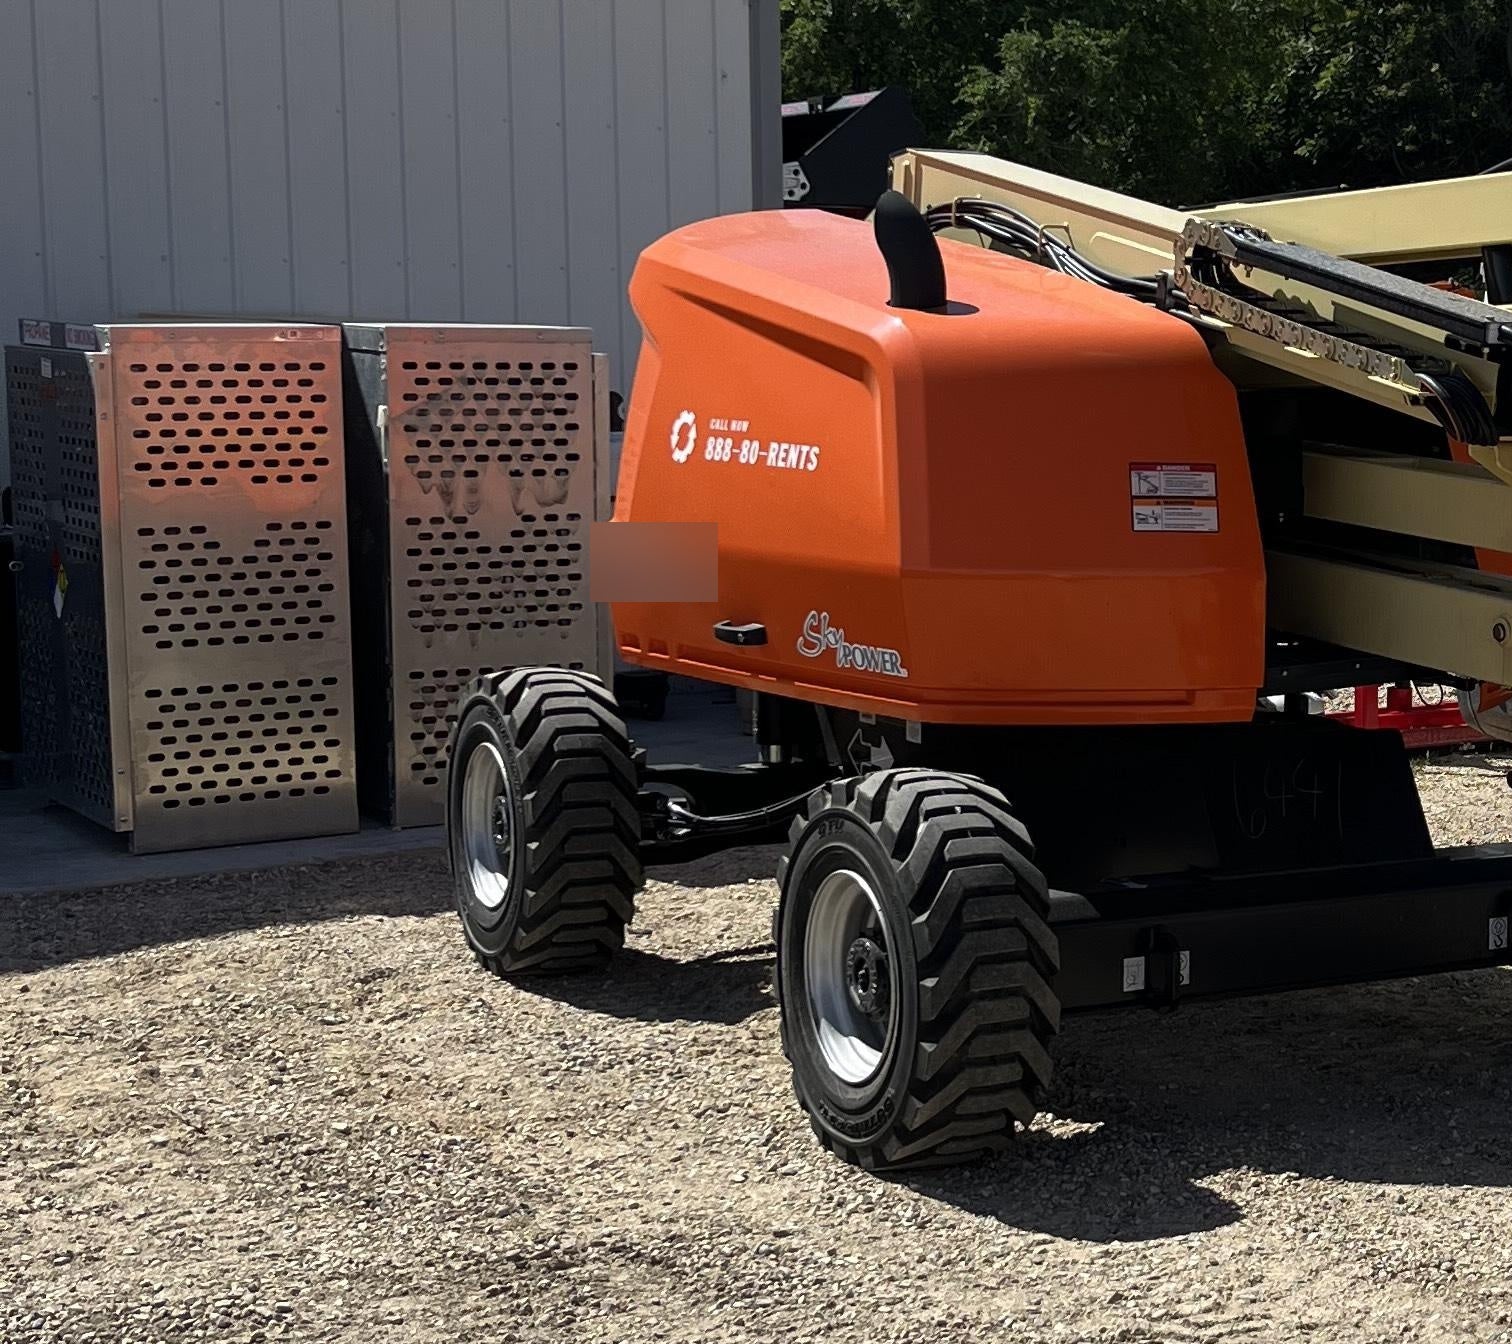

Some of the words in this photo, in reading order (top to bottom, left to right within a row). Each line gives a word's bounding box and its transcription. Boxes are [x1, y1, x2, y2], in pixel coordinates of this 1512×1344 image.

[709, 418, 729, 432] CALL
[730, 420, 750, 433] NOW
[704, 436, 820, 472] 888-80-RENTS
